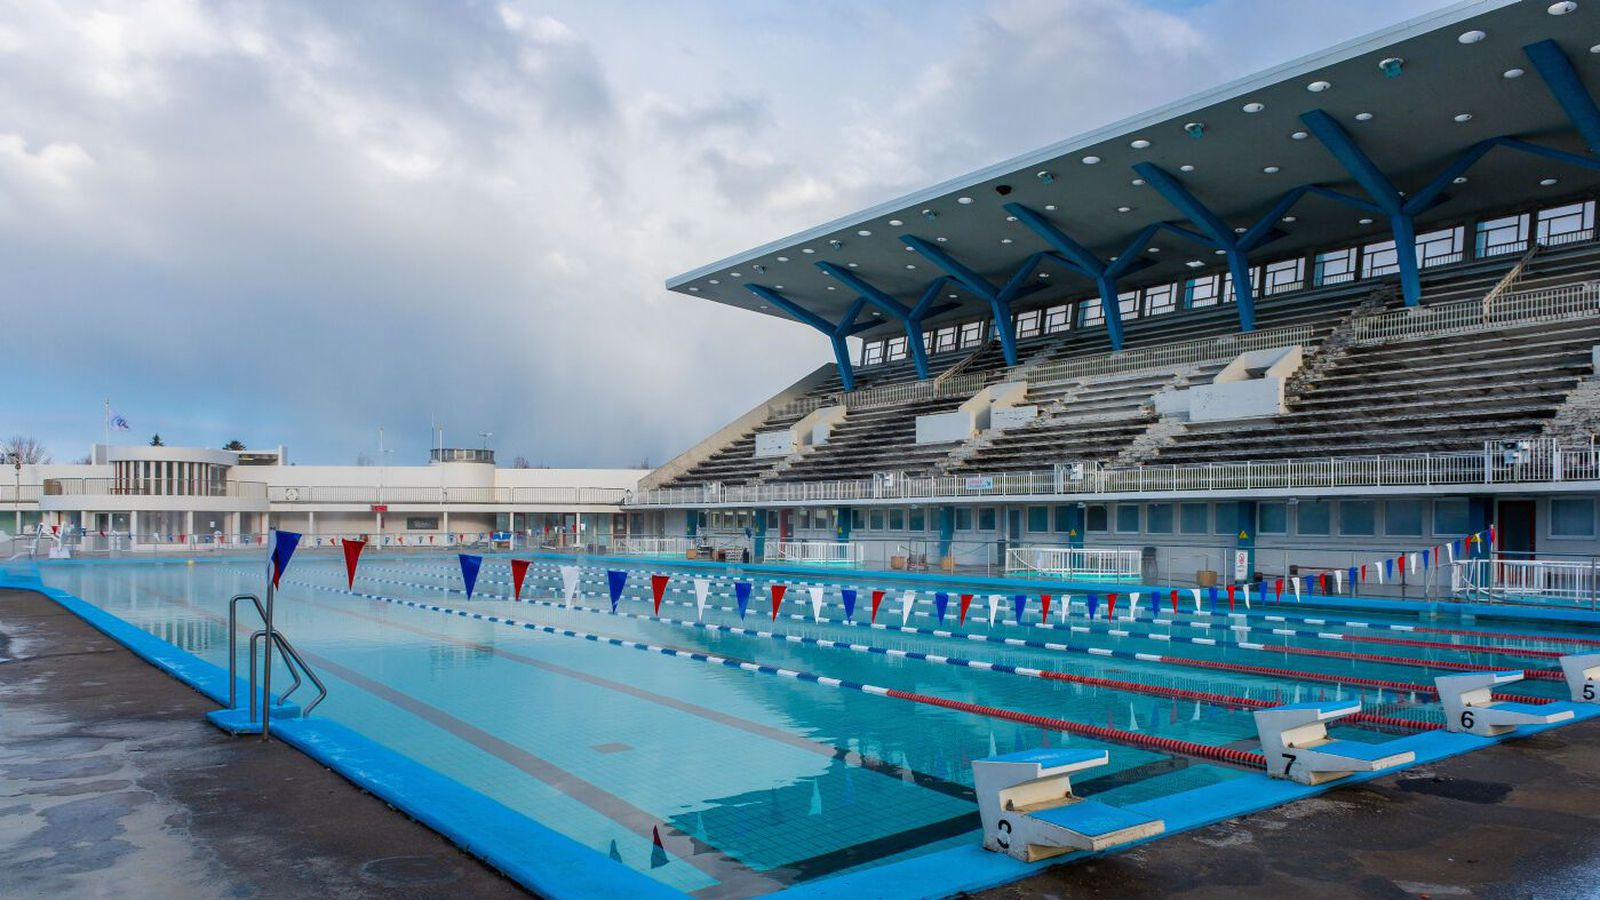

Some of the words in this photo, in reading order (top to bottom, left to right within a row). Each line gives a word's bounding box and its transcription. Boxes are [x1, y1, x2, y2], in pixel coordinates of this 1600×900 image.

[1583, 684, 1595, 700] 5
[1461, 711, 1474, 729] 6
[1282, 753, 1297, 775] 7
